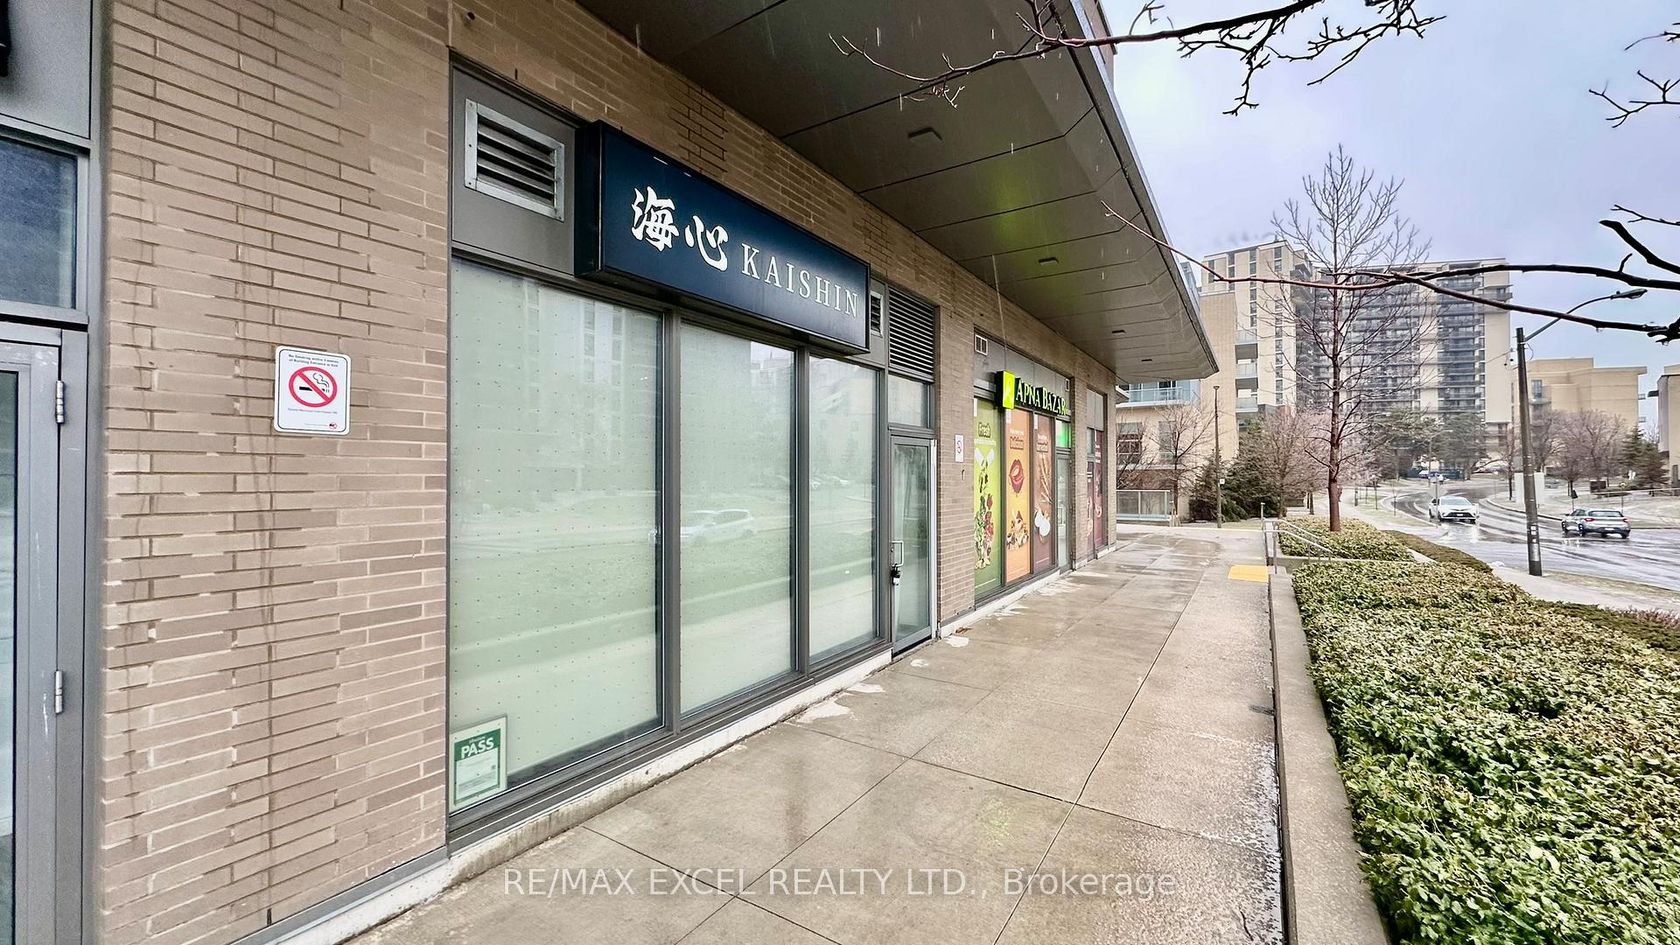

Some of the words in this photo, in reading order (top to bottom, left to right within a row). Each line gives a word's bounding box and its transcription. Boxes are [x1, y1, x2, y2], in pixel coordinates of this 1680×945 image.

[631, 186, 729, 271] 海心
[741, 243, 858, 318] KAISHIN
[1016, 378, 1041, 407] APNA
[1042, 387, 1067, 415] BAZAR
[461, 737, 495, 759] PASS
